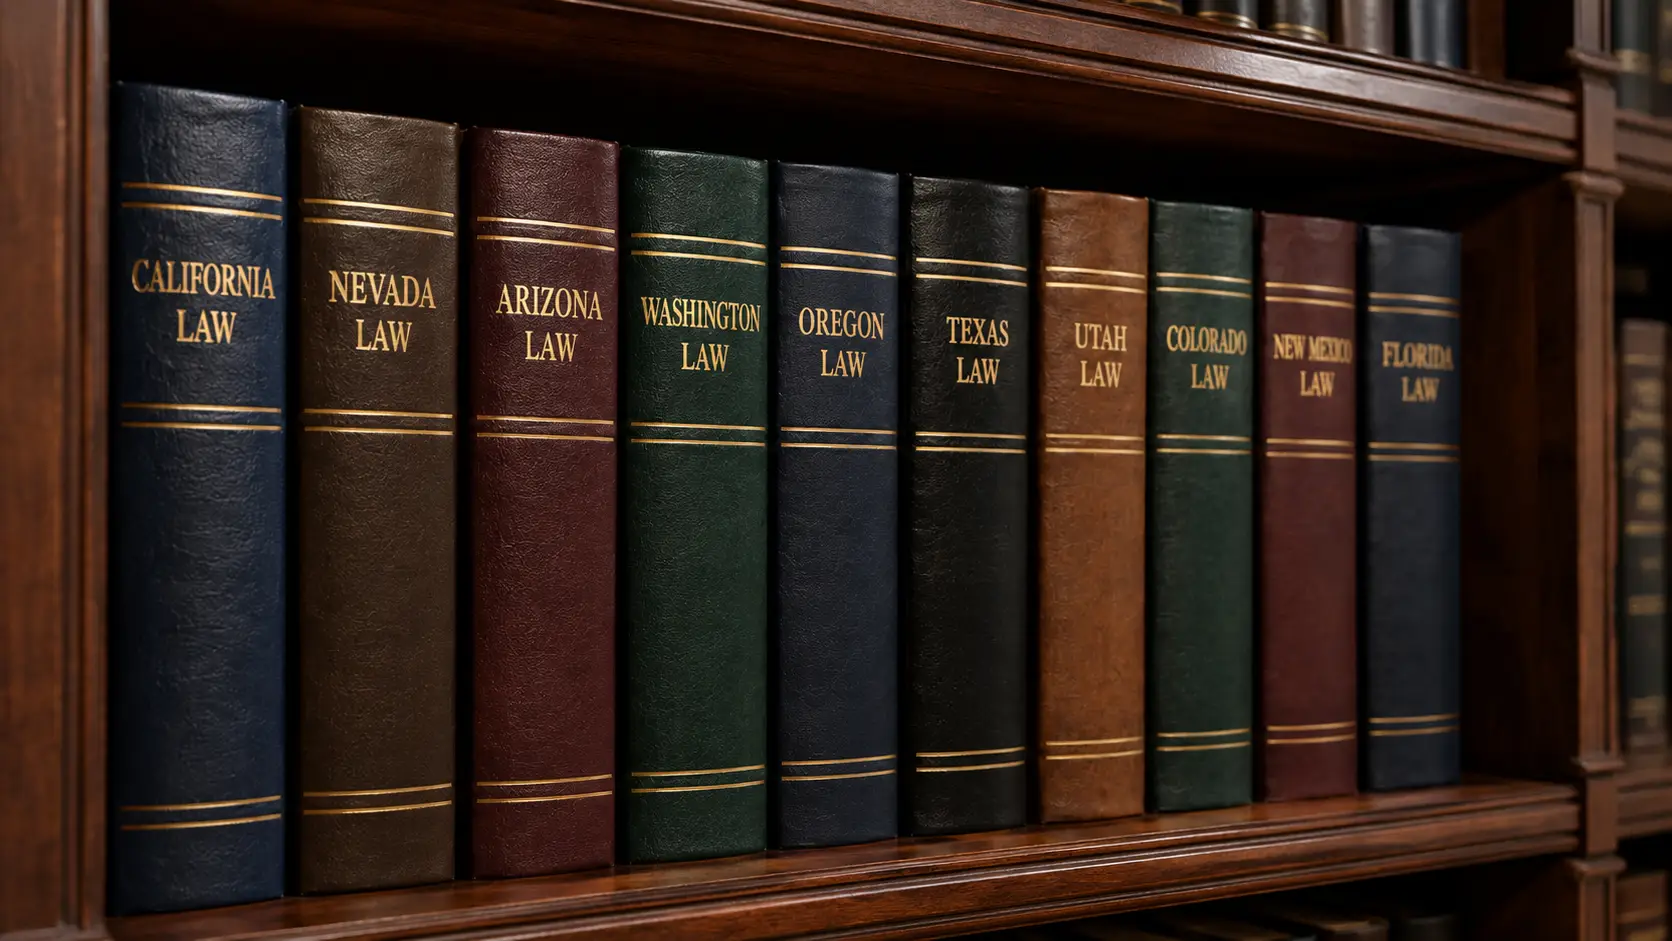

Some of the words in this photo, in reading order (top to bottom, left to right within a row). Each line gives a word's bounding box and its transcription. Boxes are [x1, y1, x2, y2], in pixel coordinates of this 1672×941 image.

[132, 259, 276, 299] CALIFORNIA
[328, 270, 437, 308] NEVADA
[496, 284, 603, 321] ARIZONA
[641, 296, 761, 333] WASHINGTON
[176, 309, 236, 344] LAW
[355, 319, 412, 353] LAW
[798, 307, 885, 340] OREGON
[946, 316, 1009, 348] TEXAS
[1075, 322, 1127, 352] UTAH
[525, 331, 577, 362] LAW
[1166, 324, 1247, 356] COLORADO
[1273, 333, 1306, 360] NEW
[1308, 336, 1352, 363] MEXICO
[681, 342, 730, 372] LAW
[821, 349, 867, 378] LAW
[1382, 341, 1453, 370] FLORIDA
[956, 357, 1000, 385] LAW
[1080, 360, 1122, 388] LAW
[1191, 364, 1229, 390] LAW
[1300, 371, 1335, 397] LAW
[1402, 377, 1439, 401] LAW
